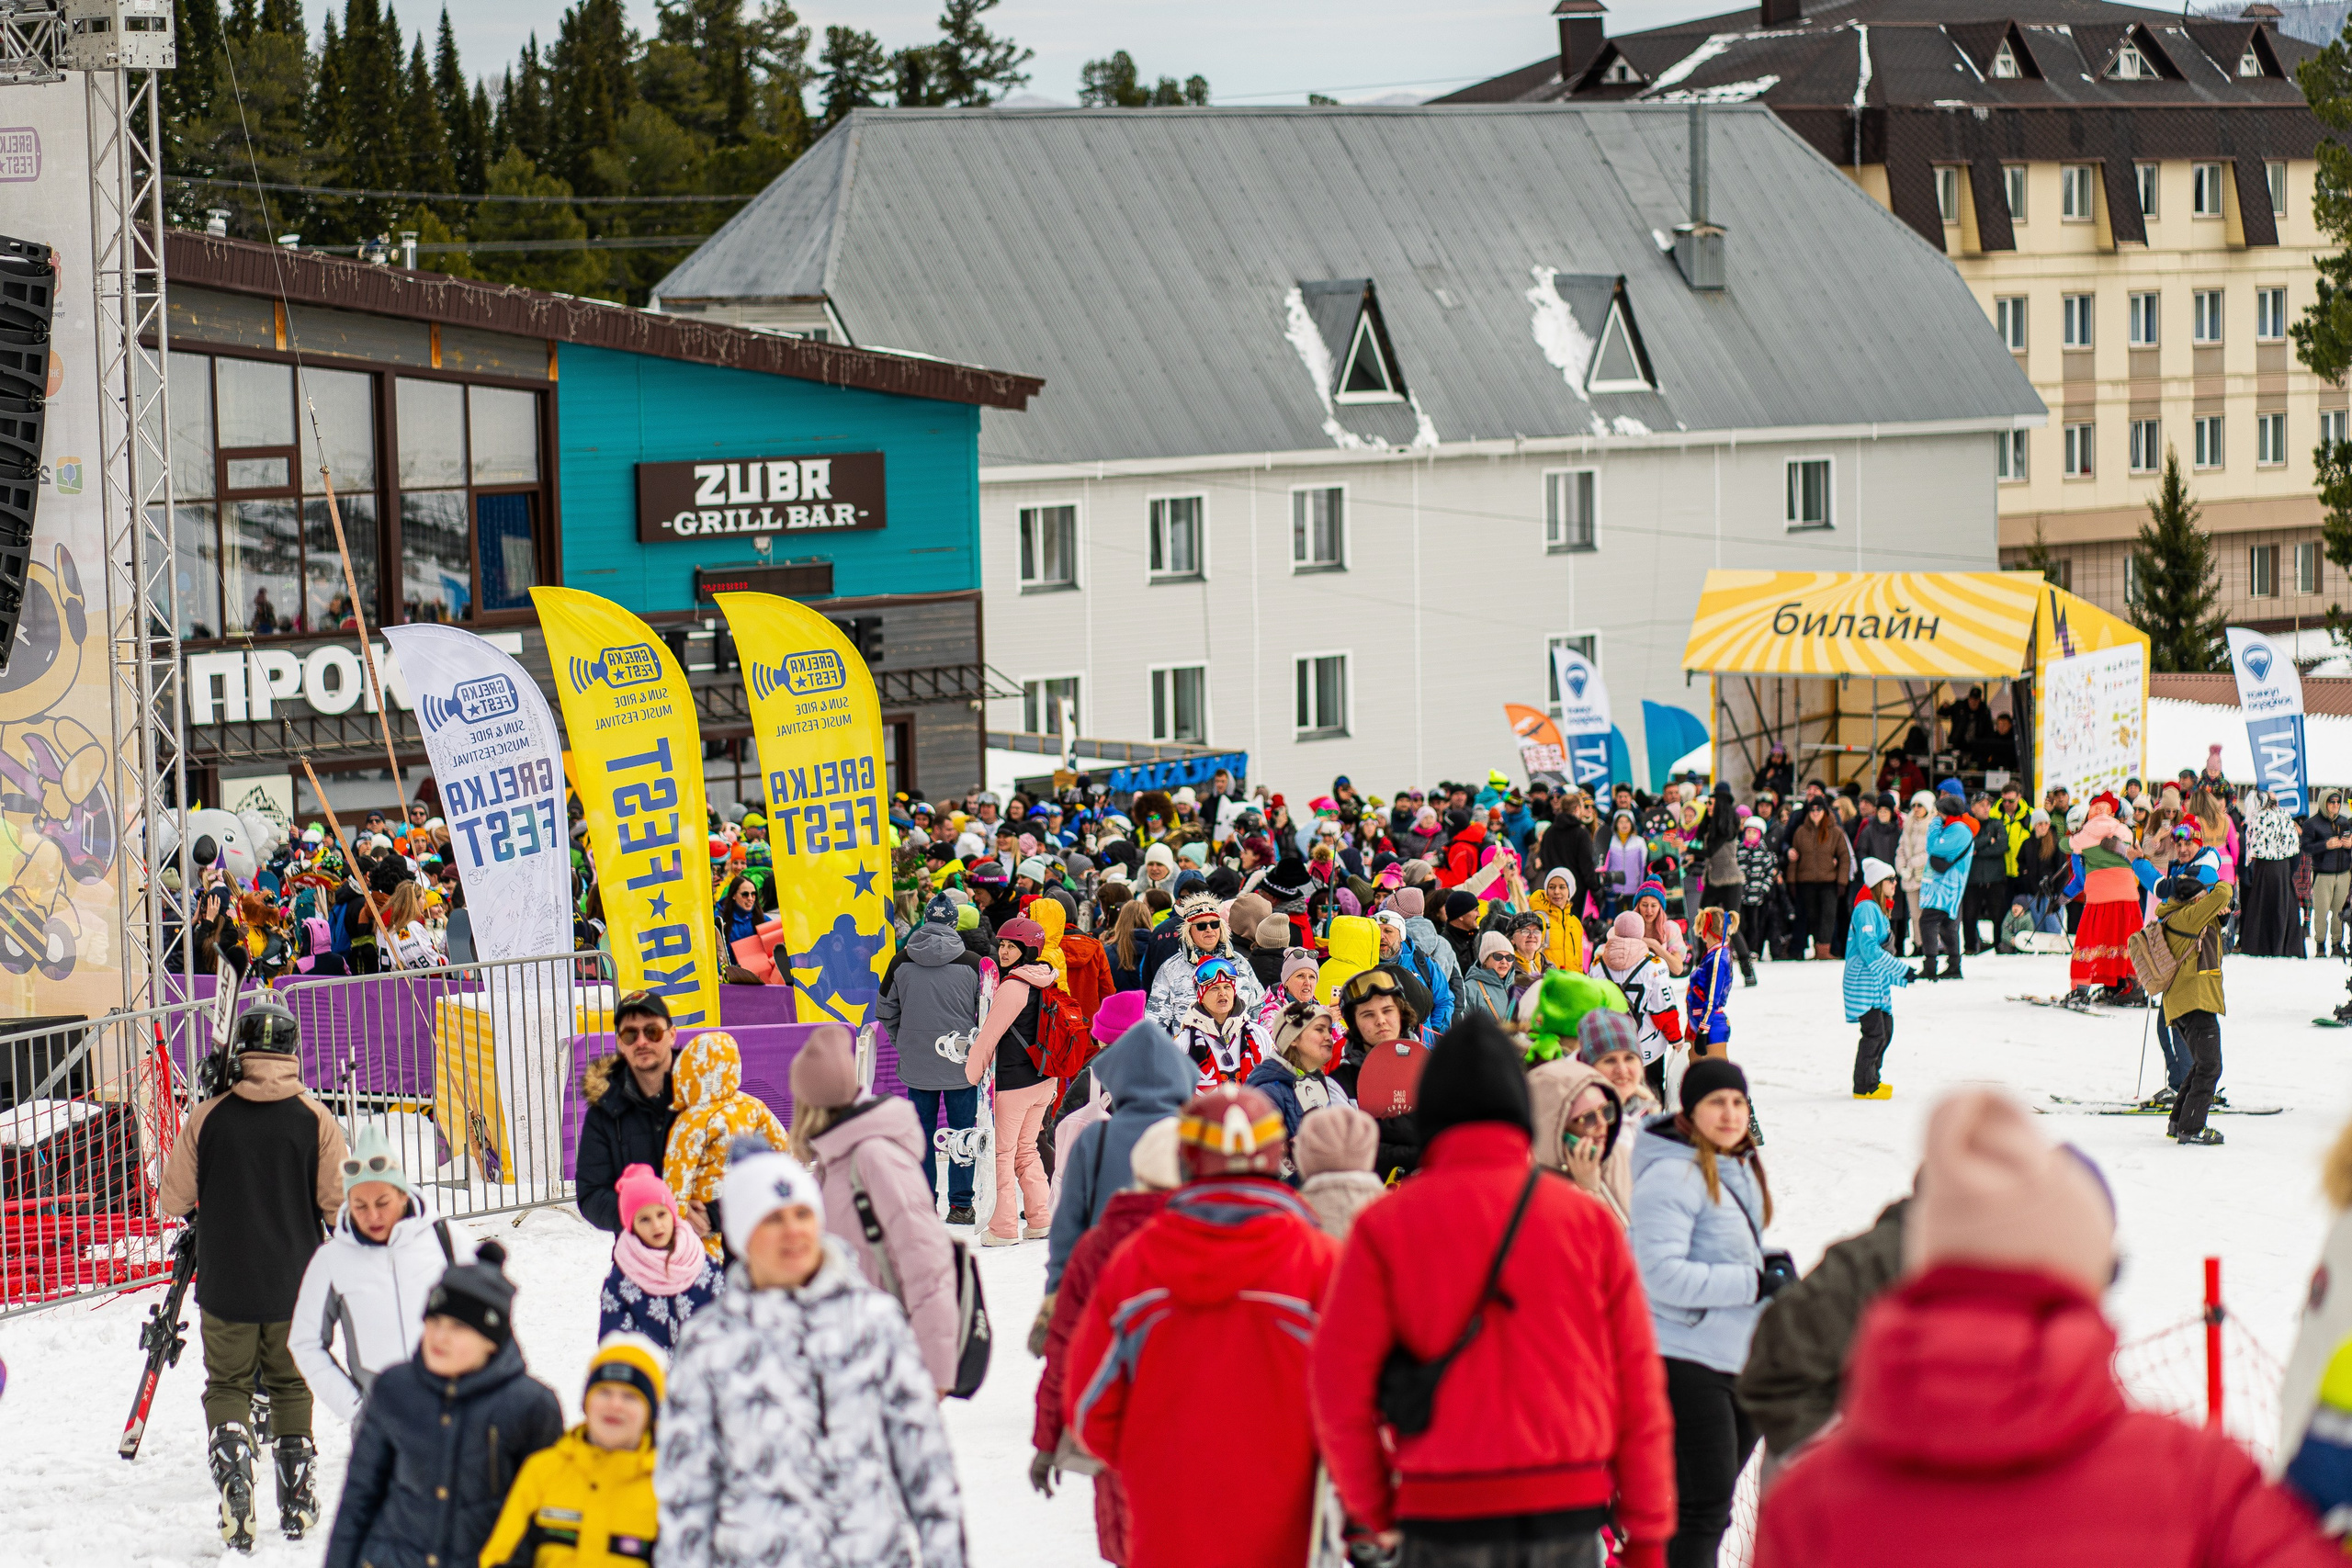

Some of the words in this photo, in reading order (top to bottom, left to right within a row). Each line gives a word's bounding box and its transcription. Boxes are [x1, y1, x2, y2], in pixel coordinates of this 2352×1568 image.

[694, 458, 832, 506] ZUBR
[1772, 601, 1939, 641] билайн
[187, 632, 523, 726] ПРОК
[1108, 751, 1249, 794] МАГАЗИН
[216, 962, 231, 1034] HEAD
[141, 1374, 154, 1402] XTR
